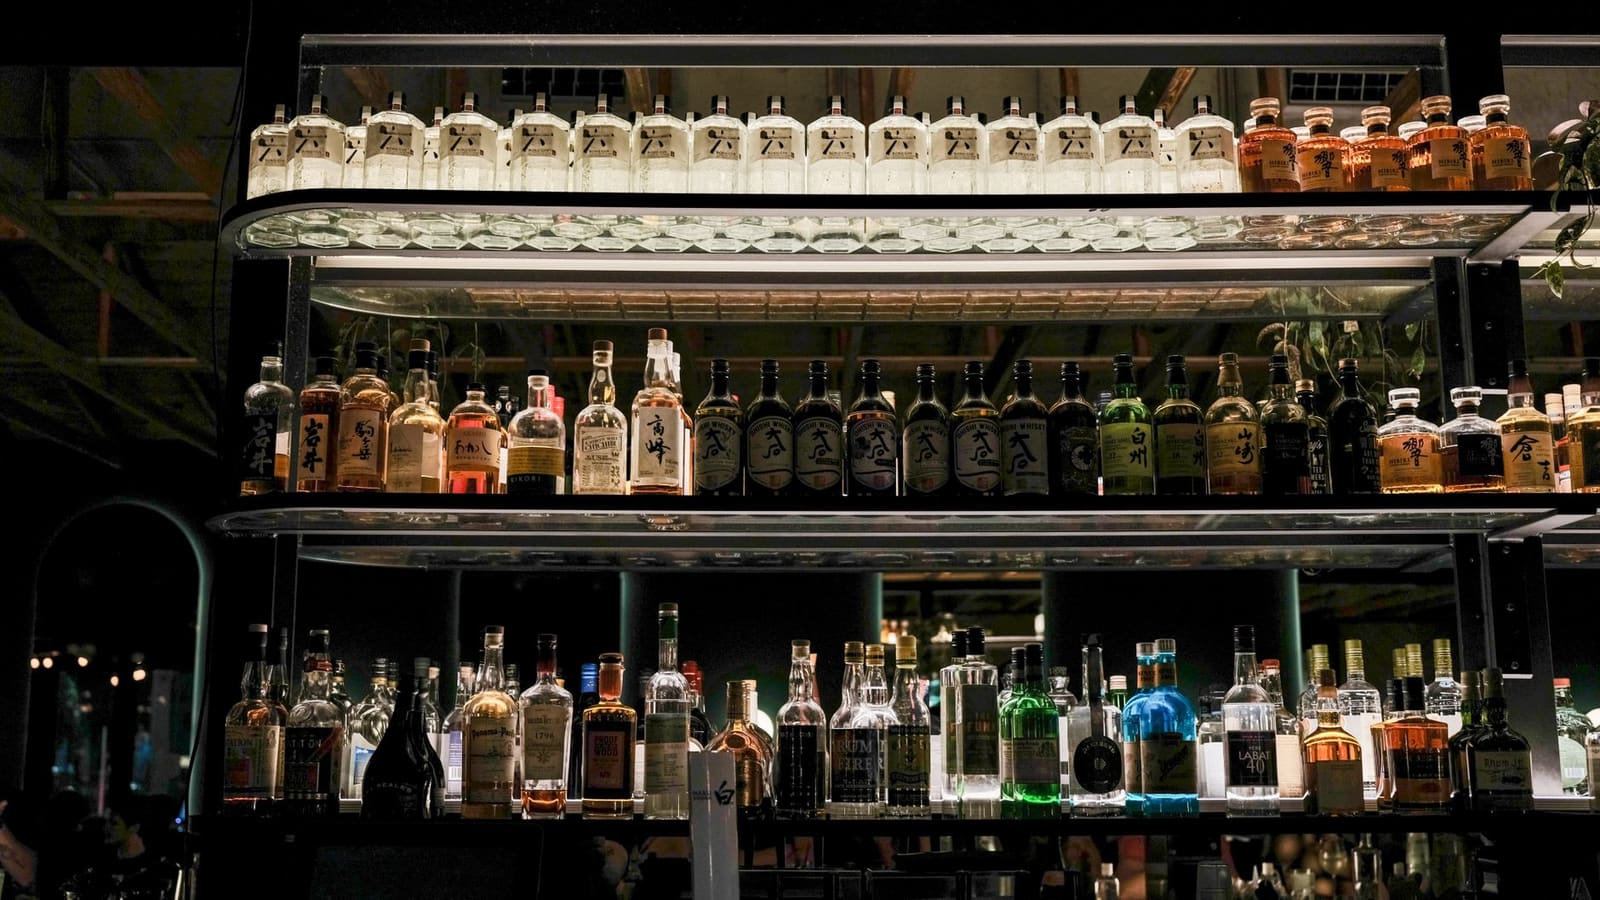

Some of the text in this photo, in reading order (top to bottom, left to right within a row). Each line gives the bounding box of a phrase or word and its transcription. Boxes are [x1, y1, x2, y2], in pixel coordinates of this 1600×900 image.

[295, 129, 327, 153] 六
[379, 125, 412, 149] 六
[449, 127, 482, 151] 六
[522, 127, 554, 152] 六
[583, 128, 615, 153] 六
[640, 129, 672, 154] 六
[708, 129, 740, 154] 六
[760, 130, 792, 155] 六
[821, 130, 853, 155] 六
[884, 130, 916, 155] 六
[945, 130, 977, 155] 六
[1006, 130, 1037, 154] 六
[1059, 130, 1091, 154] 六
[1119, 129, 1150, 154] 六
[1189, 130, 1222, 155] 六
[1020, 423, 1046, 431] WHISKY
[301, 418, 323, 473] 岩井
[646, 414, 671, 467] 高峰
[1130, 427, 1148, 468] 白州
[1235, 428, 1256, 465] 山崎
[1403, 437, 1428, 467] 響
[1510, 434, 1551, 481] 倉吉
[1239, 751, 1271, 761] LABAT
[1246, 760, 1265, 774] 40
[714, 780, 735, 805] 白
